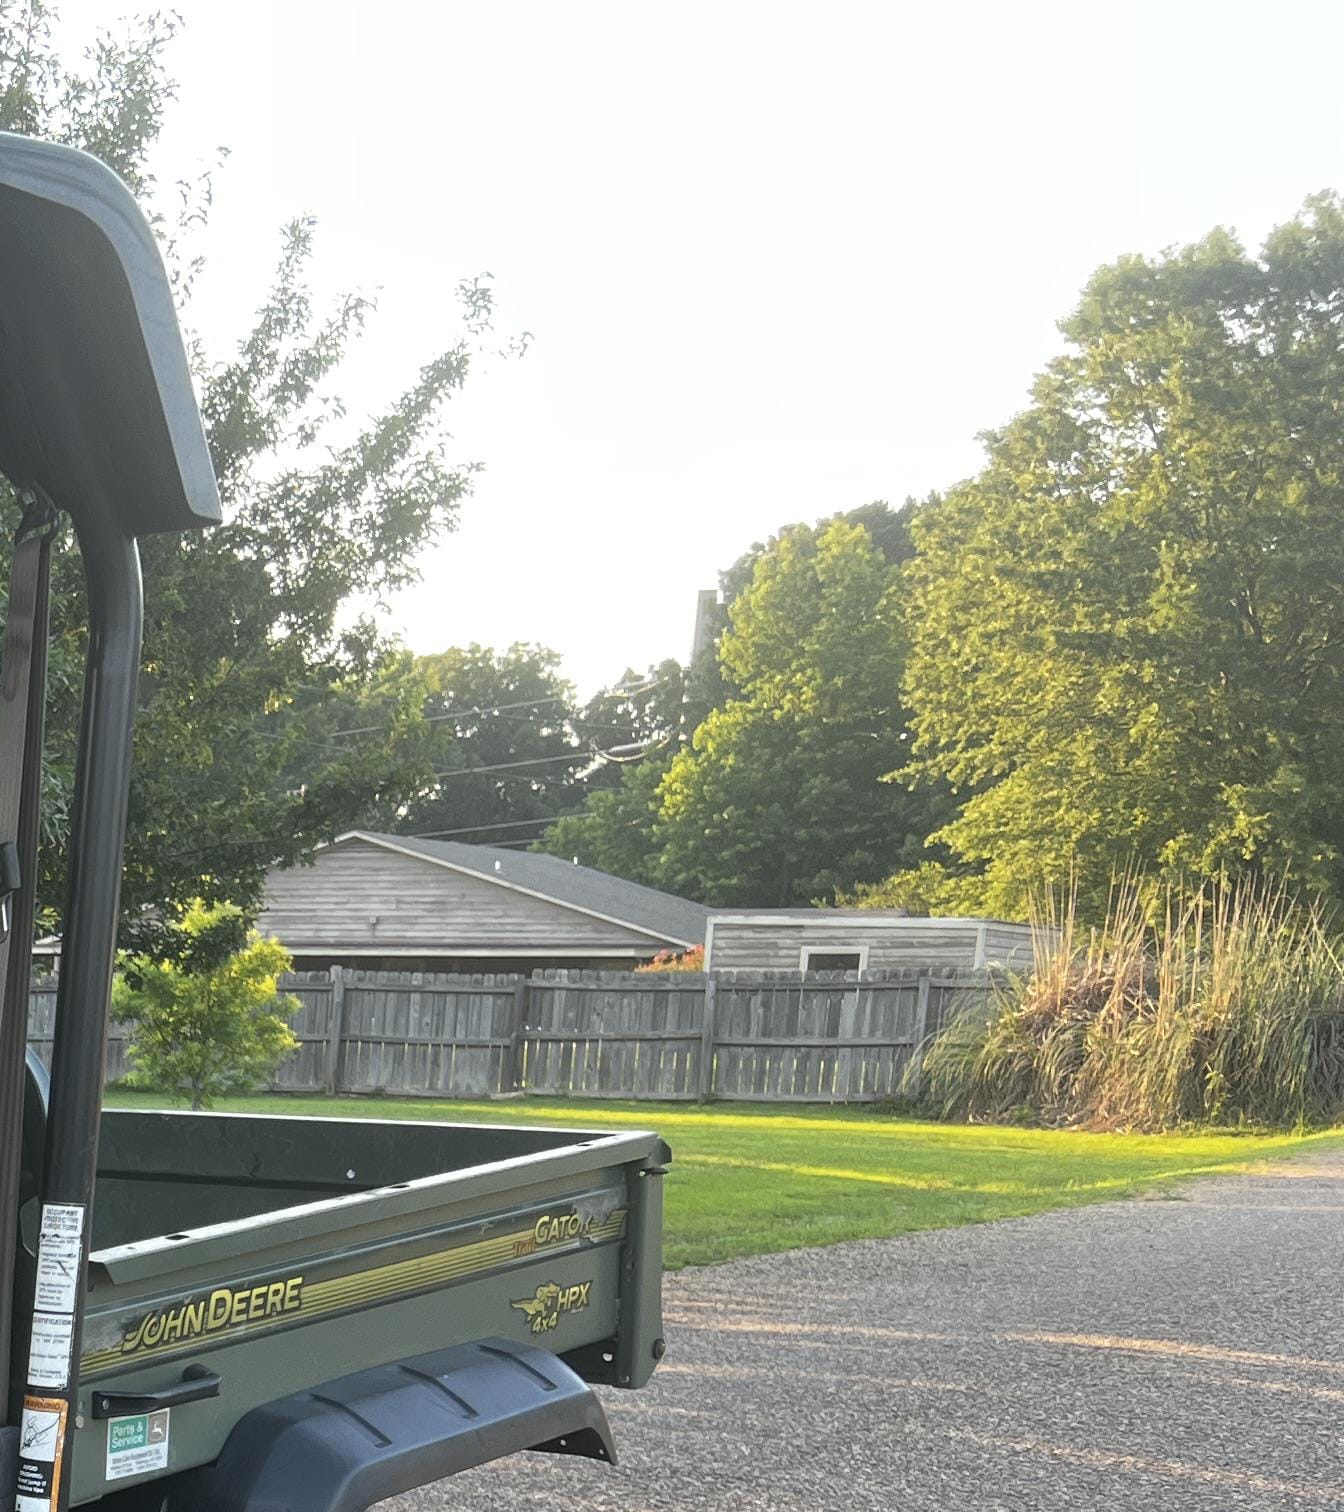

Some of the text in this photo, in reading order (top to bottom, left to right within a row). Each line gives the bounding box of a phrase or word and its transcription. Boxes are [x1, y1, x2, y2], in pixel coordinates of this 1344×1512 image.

[556, 1282, 591, 1312] HPX
[121, 1276, 304, 1353] JOHN DEERE
[532, 1311, 558, 1333] 4x4
[112, 1421, 144, 1438] Parts &
[112, 1434, 144, 1449] Service
